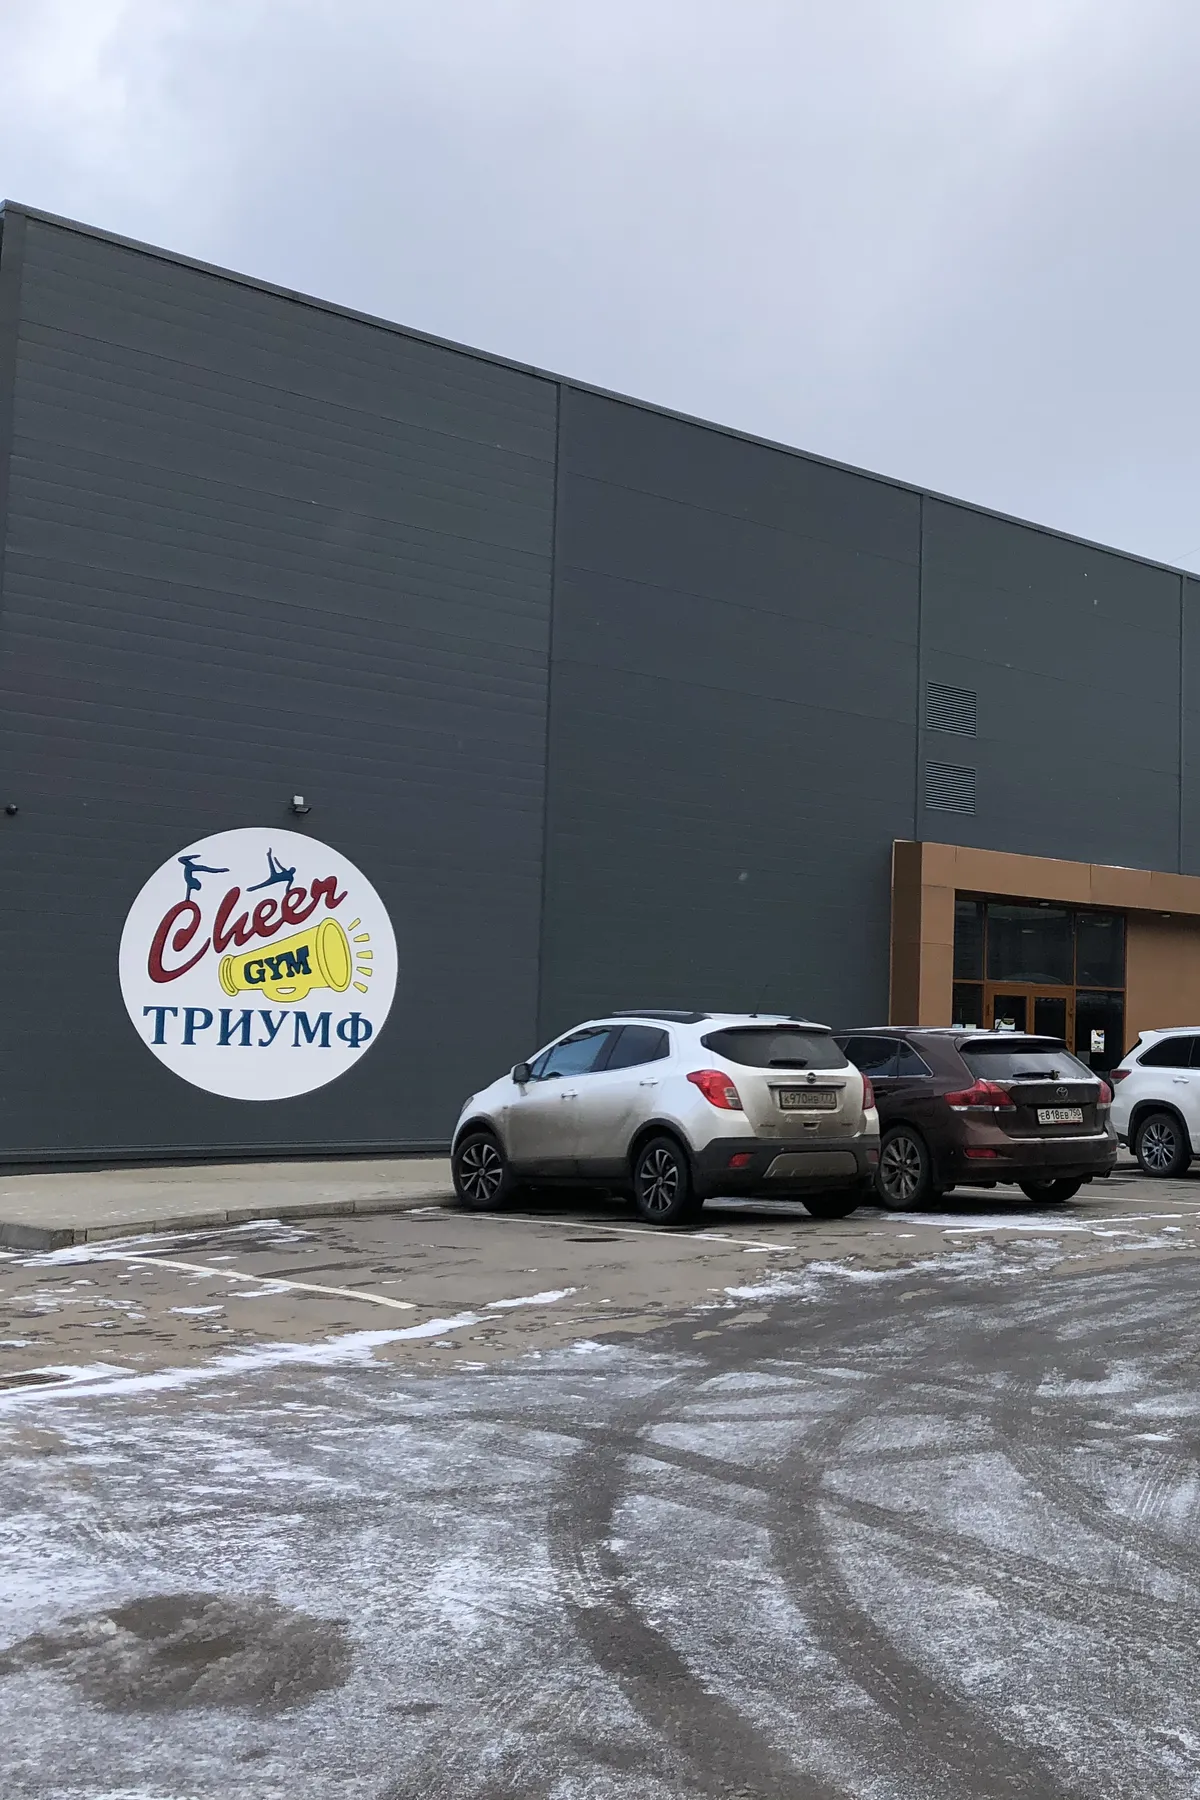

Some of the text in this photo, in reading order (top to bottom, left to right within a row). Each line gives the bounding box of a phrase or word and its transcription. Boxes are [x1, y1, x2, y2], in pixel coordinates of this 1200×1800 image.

[148, 876, 348, 983] Cheer
[244, 945, 312, 984] GYM
[143, 1005, 373, 1048] ТРИУМФ
